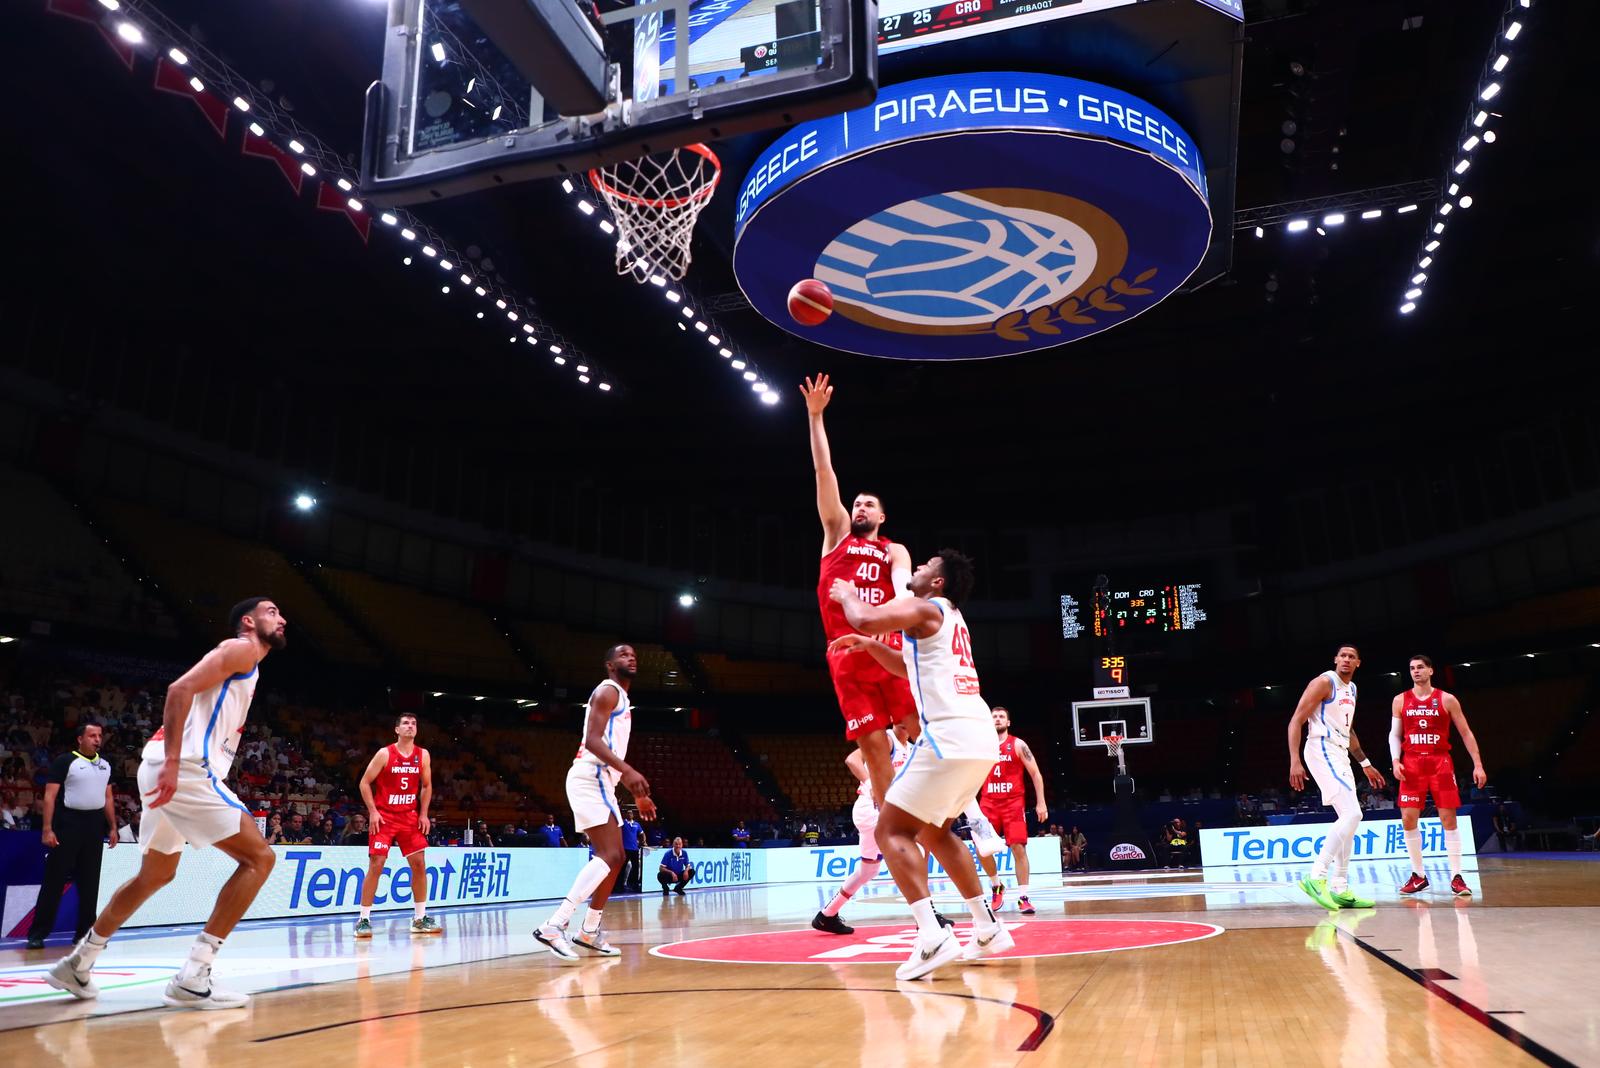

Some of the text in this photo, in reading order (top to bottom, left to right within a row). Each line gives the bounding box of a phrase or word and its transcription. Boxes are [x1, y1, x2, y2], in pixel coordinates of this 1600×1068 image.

[883, 0, 981, 32] 27 25 CRO
[873, 88, 1190, 165] PIRAEUS GREECE
[738, 130, 818, 219] GREECE
[856, 562, 881, 582] 40
[1114, 589, 1155, 600] DOM CRO
[1116, 611, 1128, 619] 27
[1146, 608, 1157, 617] 25
[1101, 656, 1125, 669] 3:35
[1111, 668, 1123, 684] 9
[1406, 709, 1440, 717] HRVATSKA
[391, 766, 420, 774] HRVATSKA
[993, 765, 1002, 778] 4
[400, 777, 409, 790] 5
[729, 851, 752, 882] 腾讯
[457, 851, 512, 900] 腾讯
